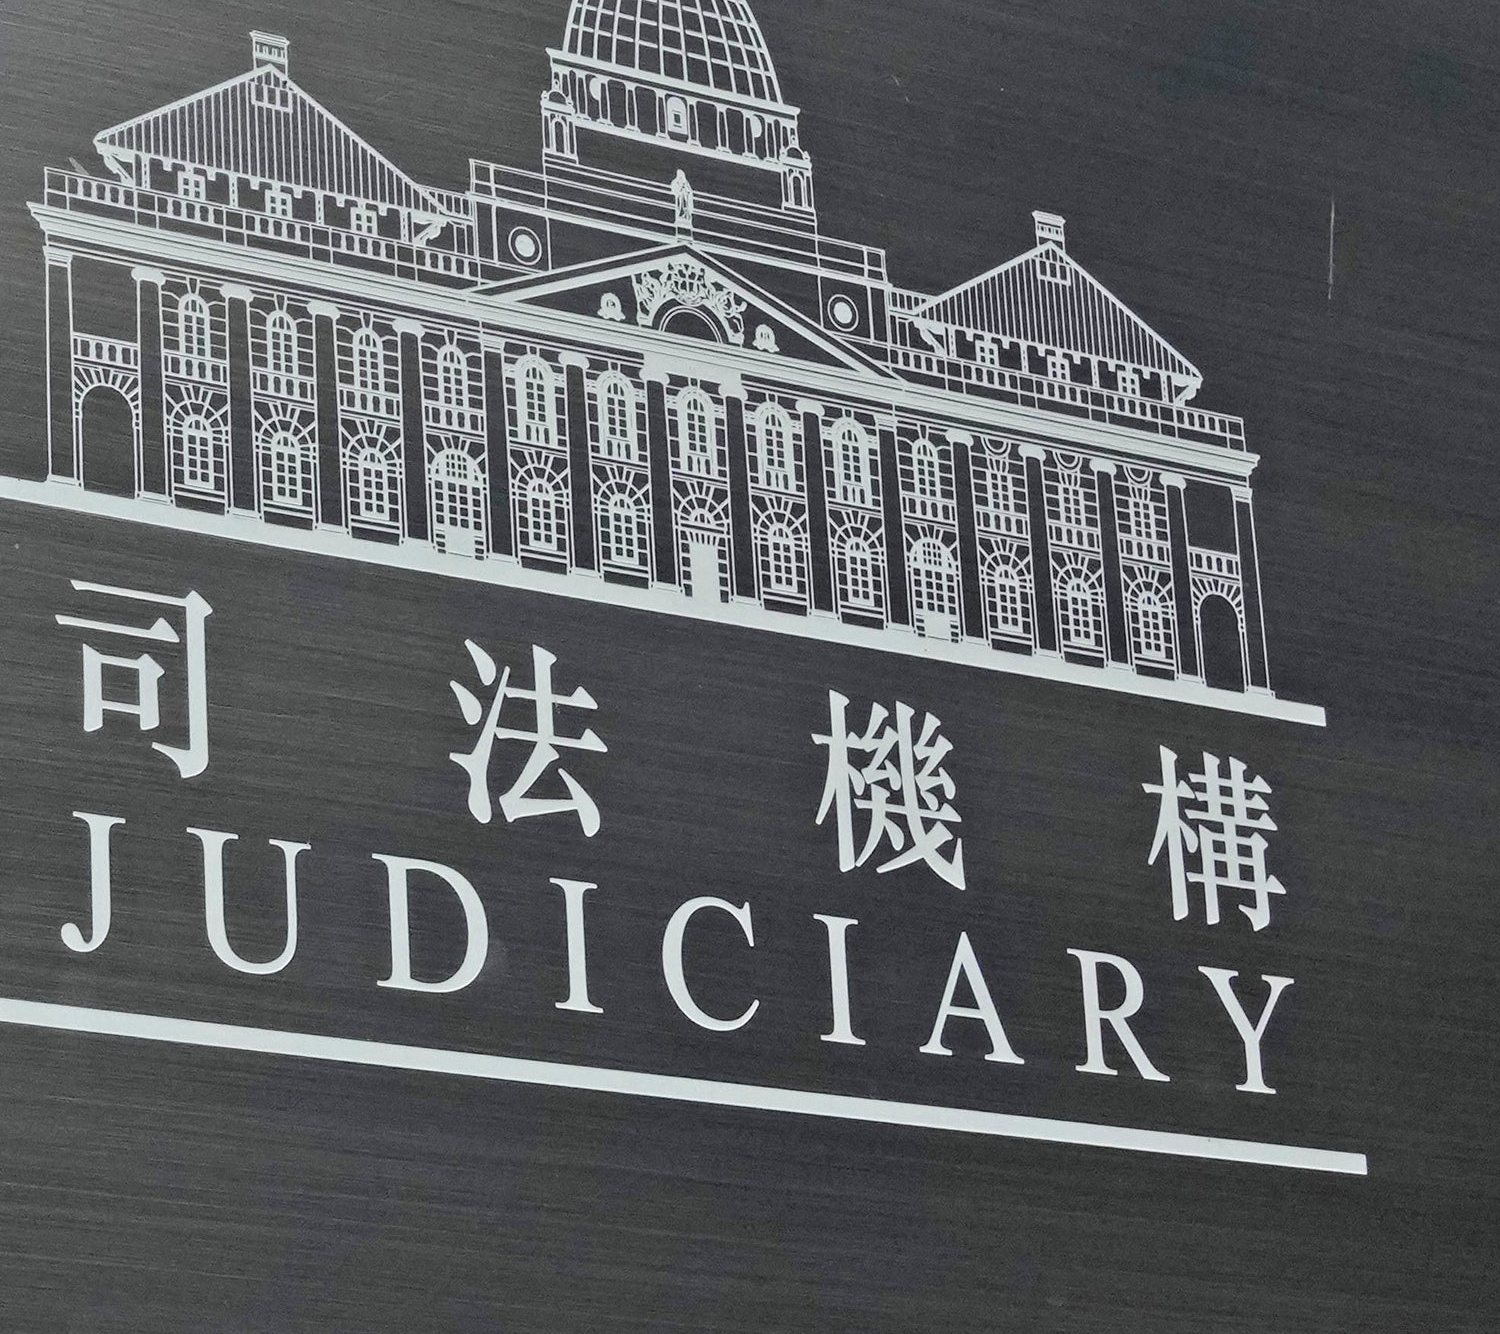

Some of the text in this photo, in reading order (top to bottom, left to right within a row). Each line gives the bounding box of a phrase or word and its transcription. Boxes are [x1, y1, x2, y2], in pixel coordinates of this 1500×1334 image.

[55, 577, 1286, 932] 司法機構
[59, 811, 1295, 1095] JUDICIARY
